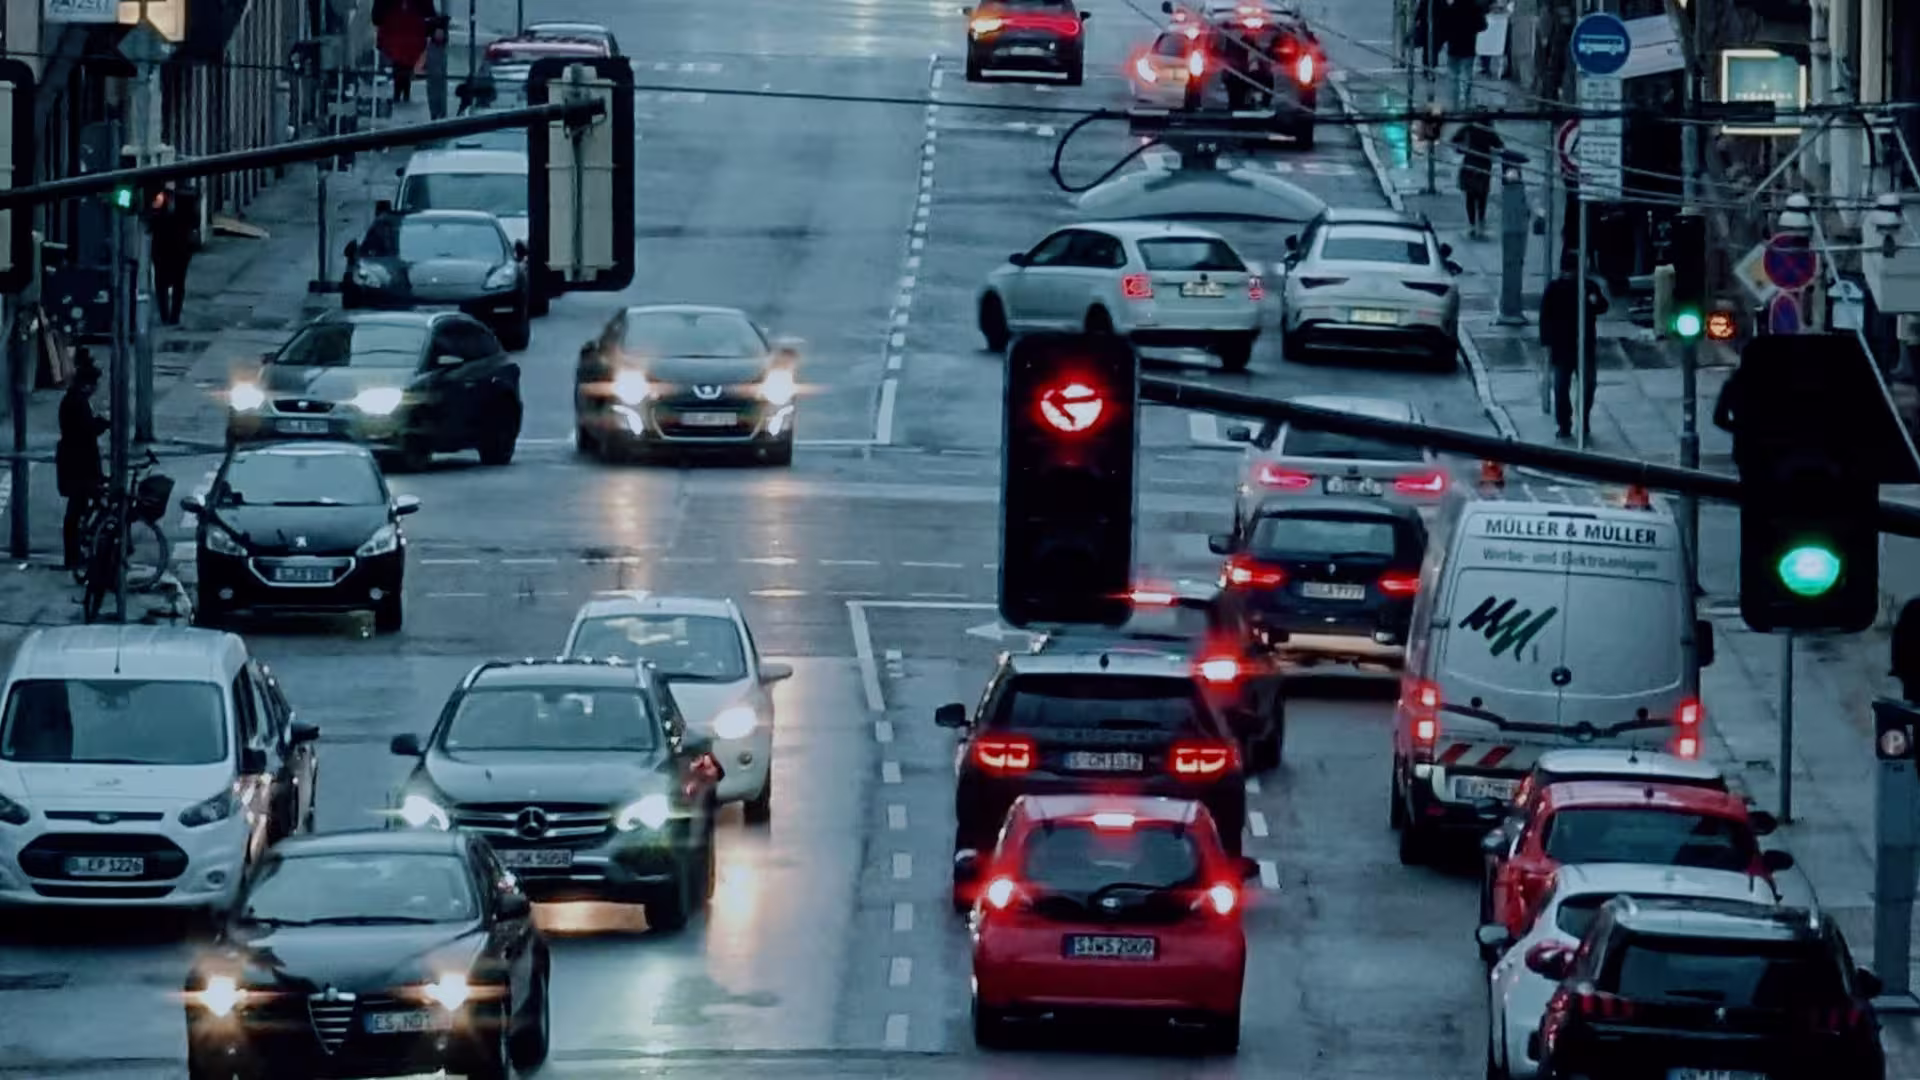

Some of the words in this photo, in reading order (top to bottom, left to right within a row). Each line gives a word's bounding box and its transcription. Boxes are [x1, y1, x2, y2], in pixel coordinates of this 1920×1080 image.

[1486, 517, 1558, 536] MÜLLER
[1565, 522, 1578, 538] &
[1585, 522, 1657, 544] MÜLLER
